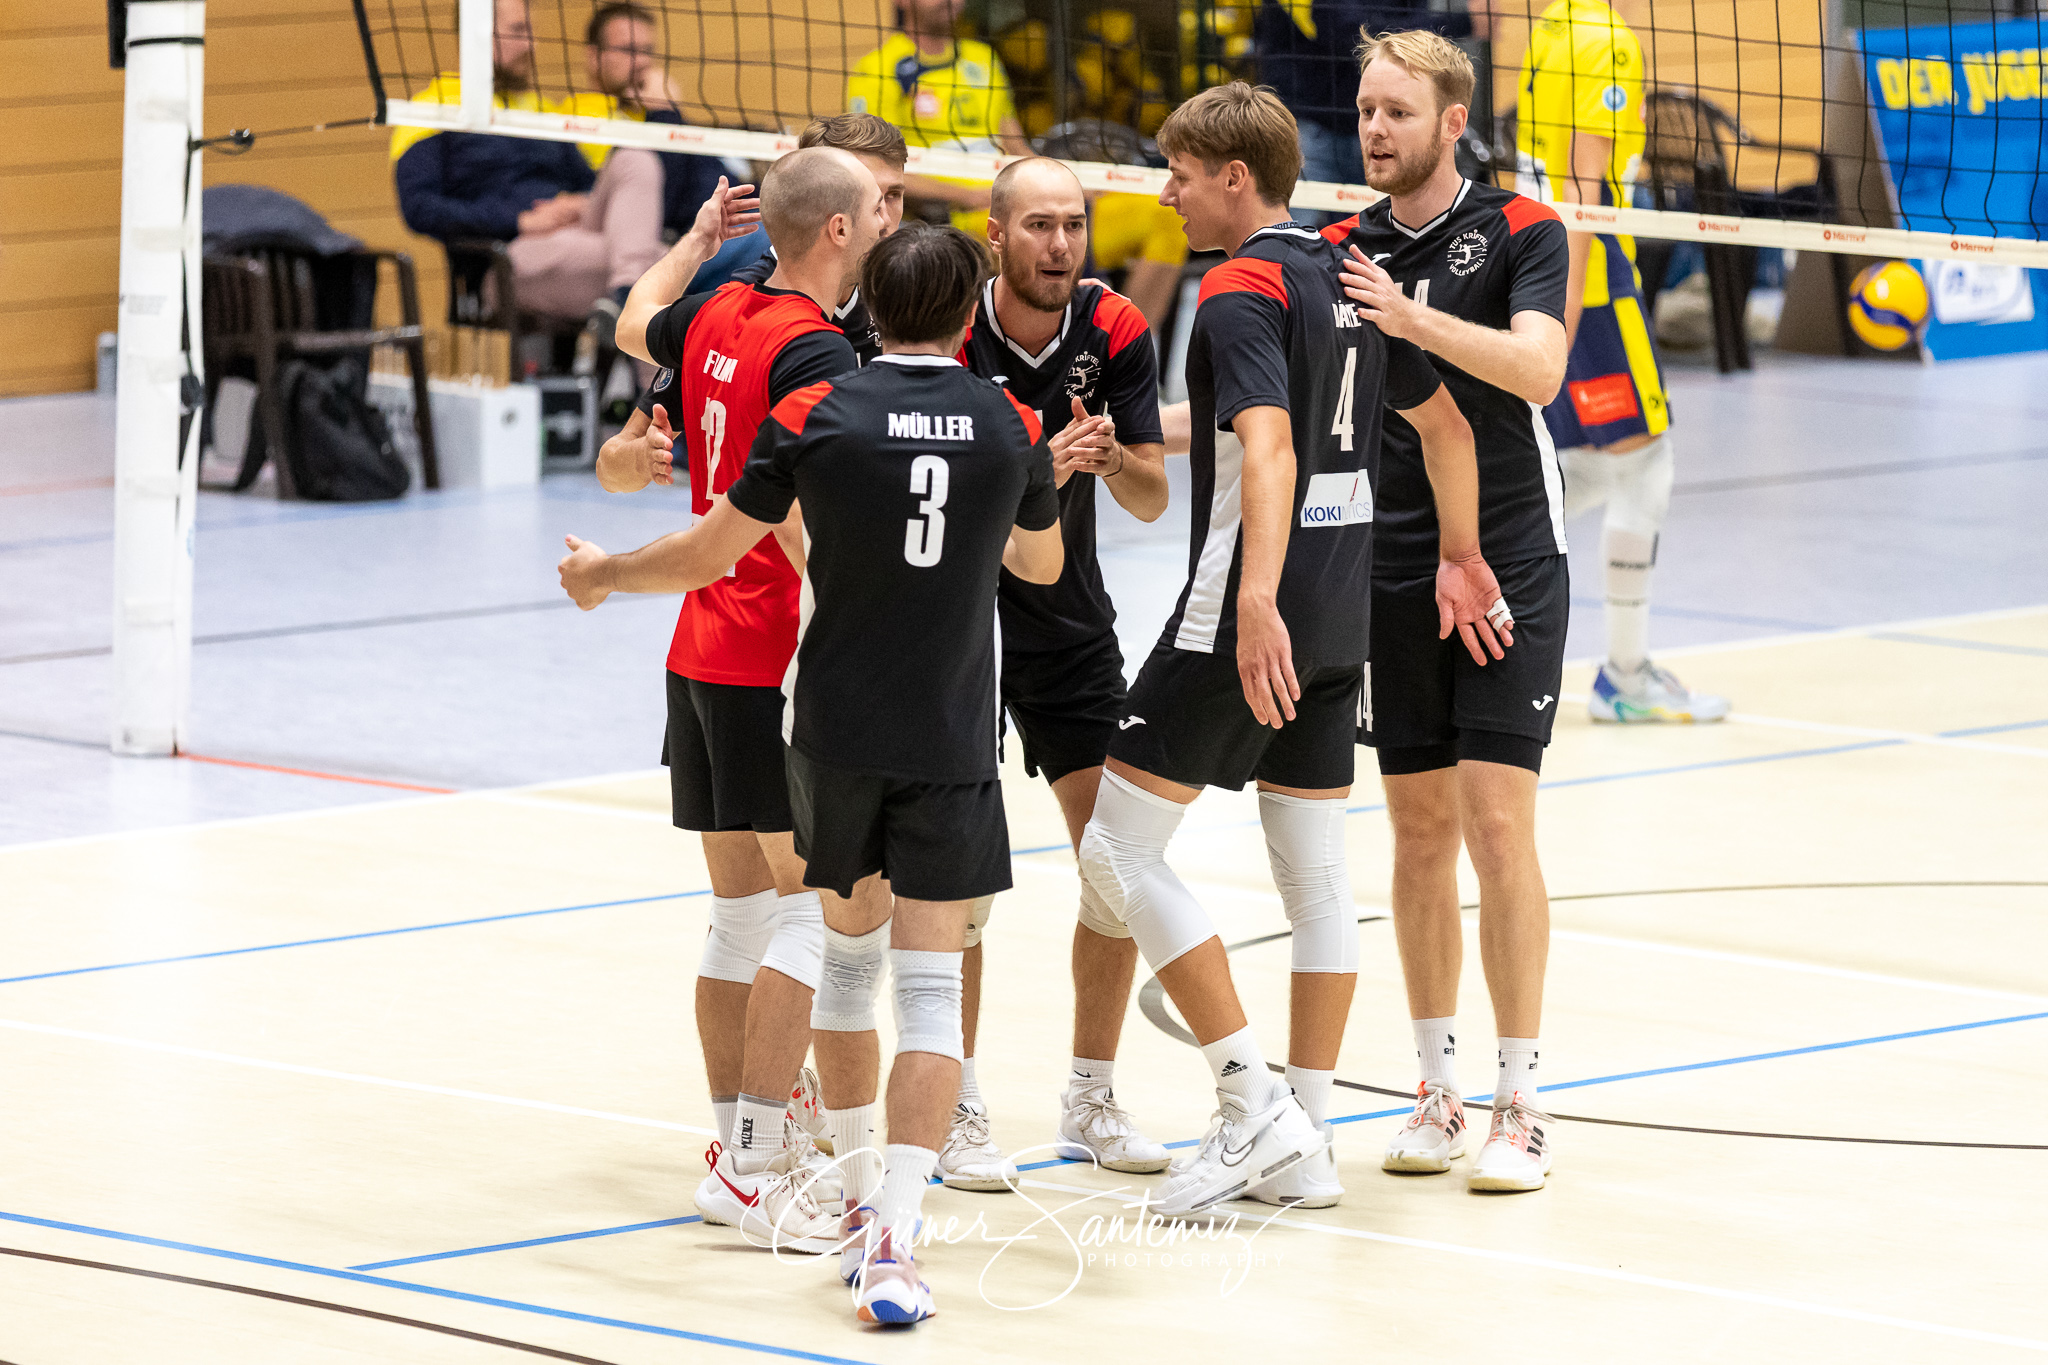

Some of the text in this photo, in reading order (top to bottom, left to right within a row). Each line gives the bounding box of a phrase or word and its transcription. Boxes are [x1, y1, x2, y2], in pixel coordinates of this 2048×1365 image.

[1876, 55, 1959, 110] DER
[1449, 229, 1488, 250] TUS KRIFTEL
[1449, 258, 1486, 276] VOLLEYBALL
[1331, 347, 1357, 451] 4
[888, 412, 974, 441] MÜLLER
[904, 455, 949, 567] 3
